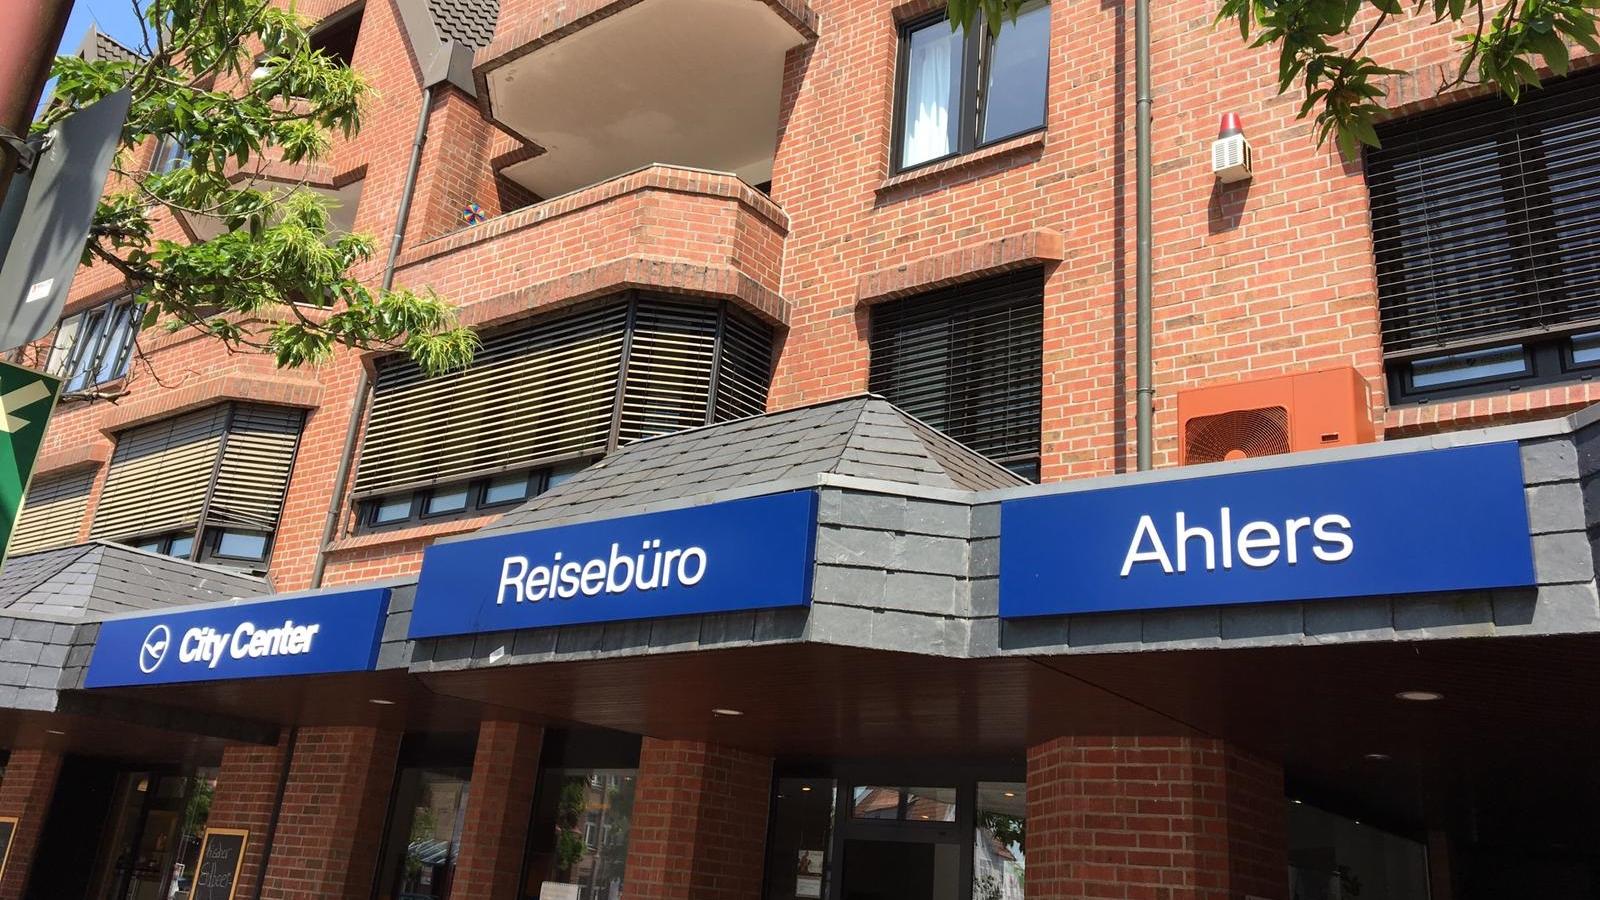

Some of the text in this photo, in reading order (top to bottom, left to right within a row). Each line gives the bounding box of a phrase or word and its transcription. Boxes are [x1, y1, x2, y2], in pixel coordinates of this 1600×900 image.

[495, 538, 708, 605] Reisebüro
[1119, 506, 1355, 577] Ahlers
[178, 619, 320, 669] City Center
